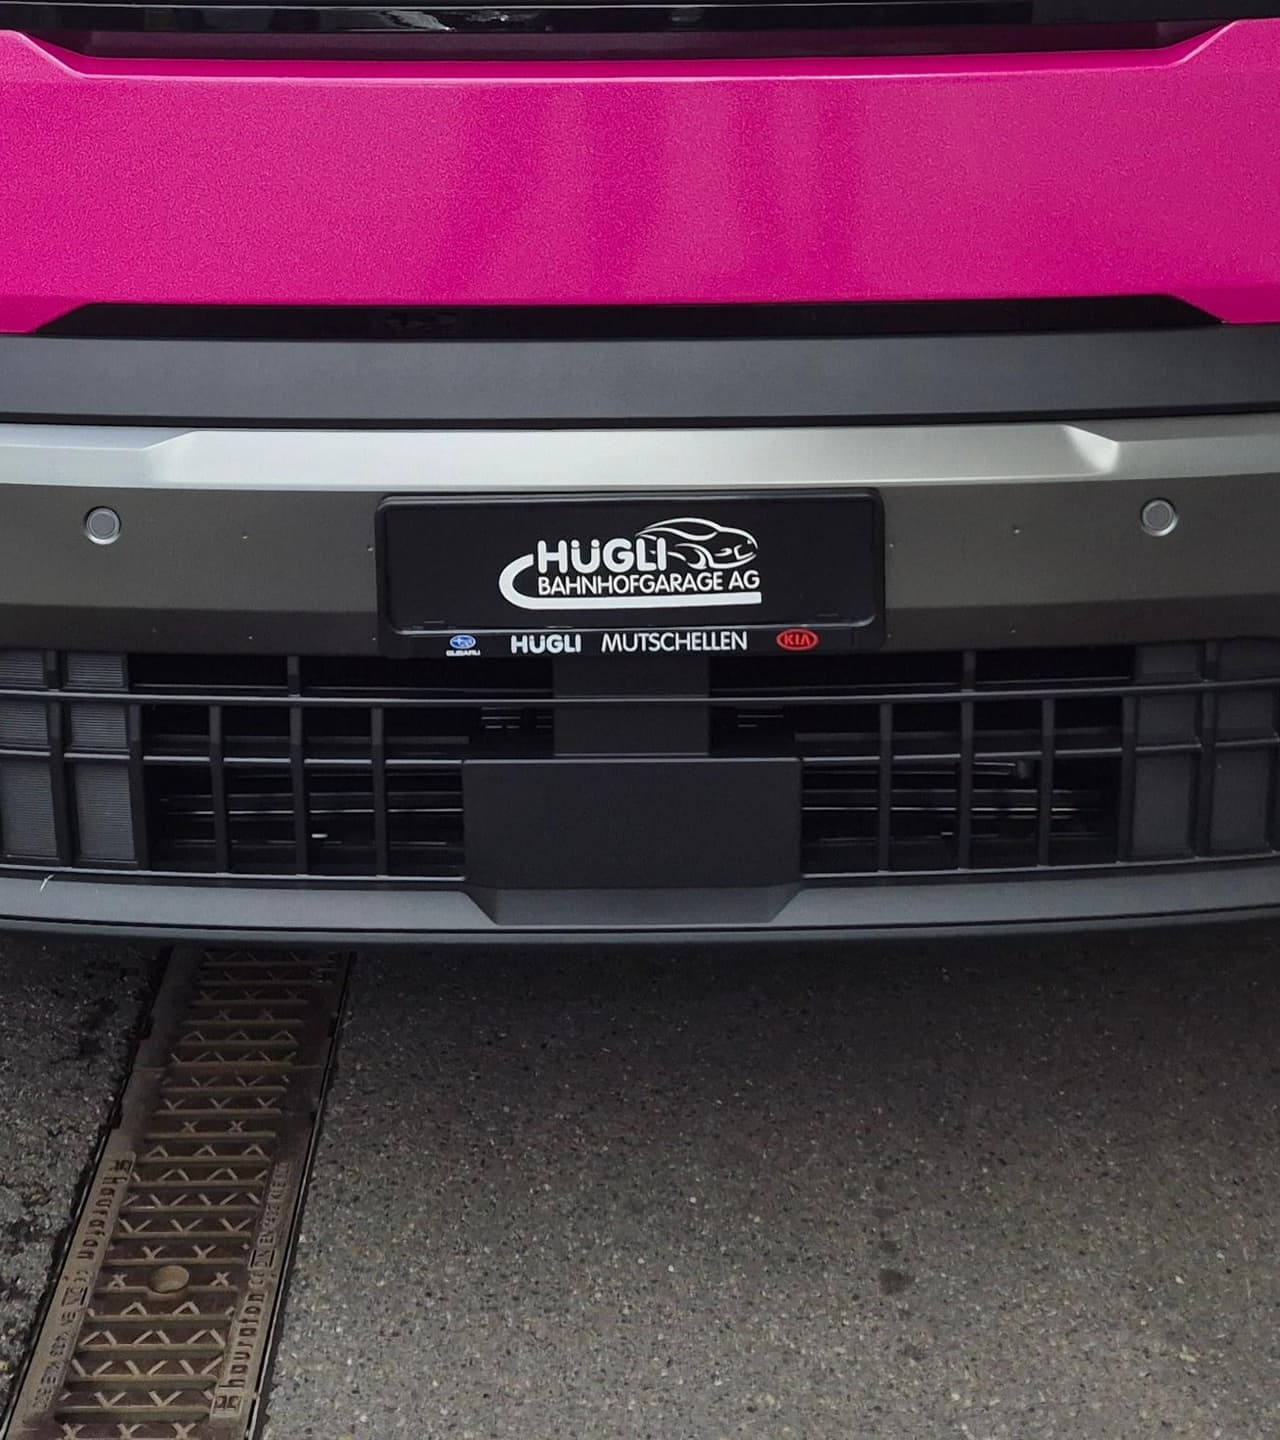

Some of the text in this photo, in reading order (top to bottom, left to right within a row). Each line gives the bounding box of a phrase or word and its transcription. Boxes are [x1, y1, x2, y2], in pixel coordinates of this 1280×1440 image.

[537, 537, 668, 574] HÜGLI
[537, 569, 761, 596] BAHNHOFGARAGE AG
[601, 630, 748, 653] MUTSCHELLEN
[783, 632, 811, 647] KIA
[217, 1292, 265, 1389] hauraton
